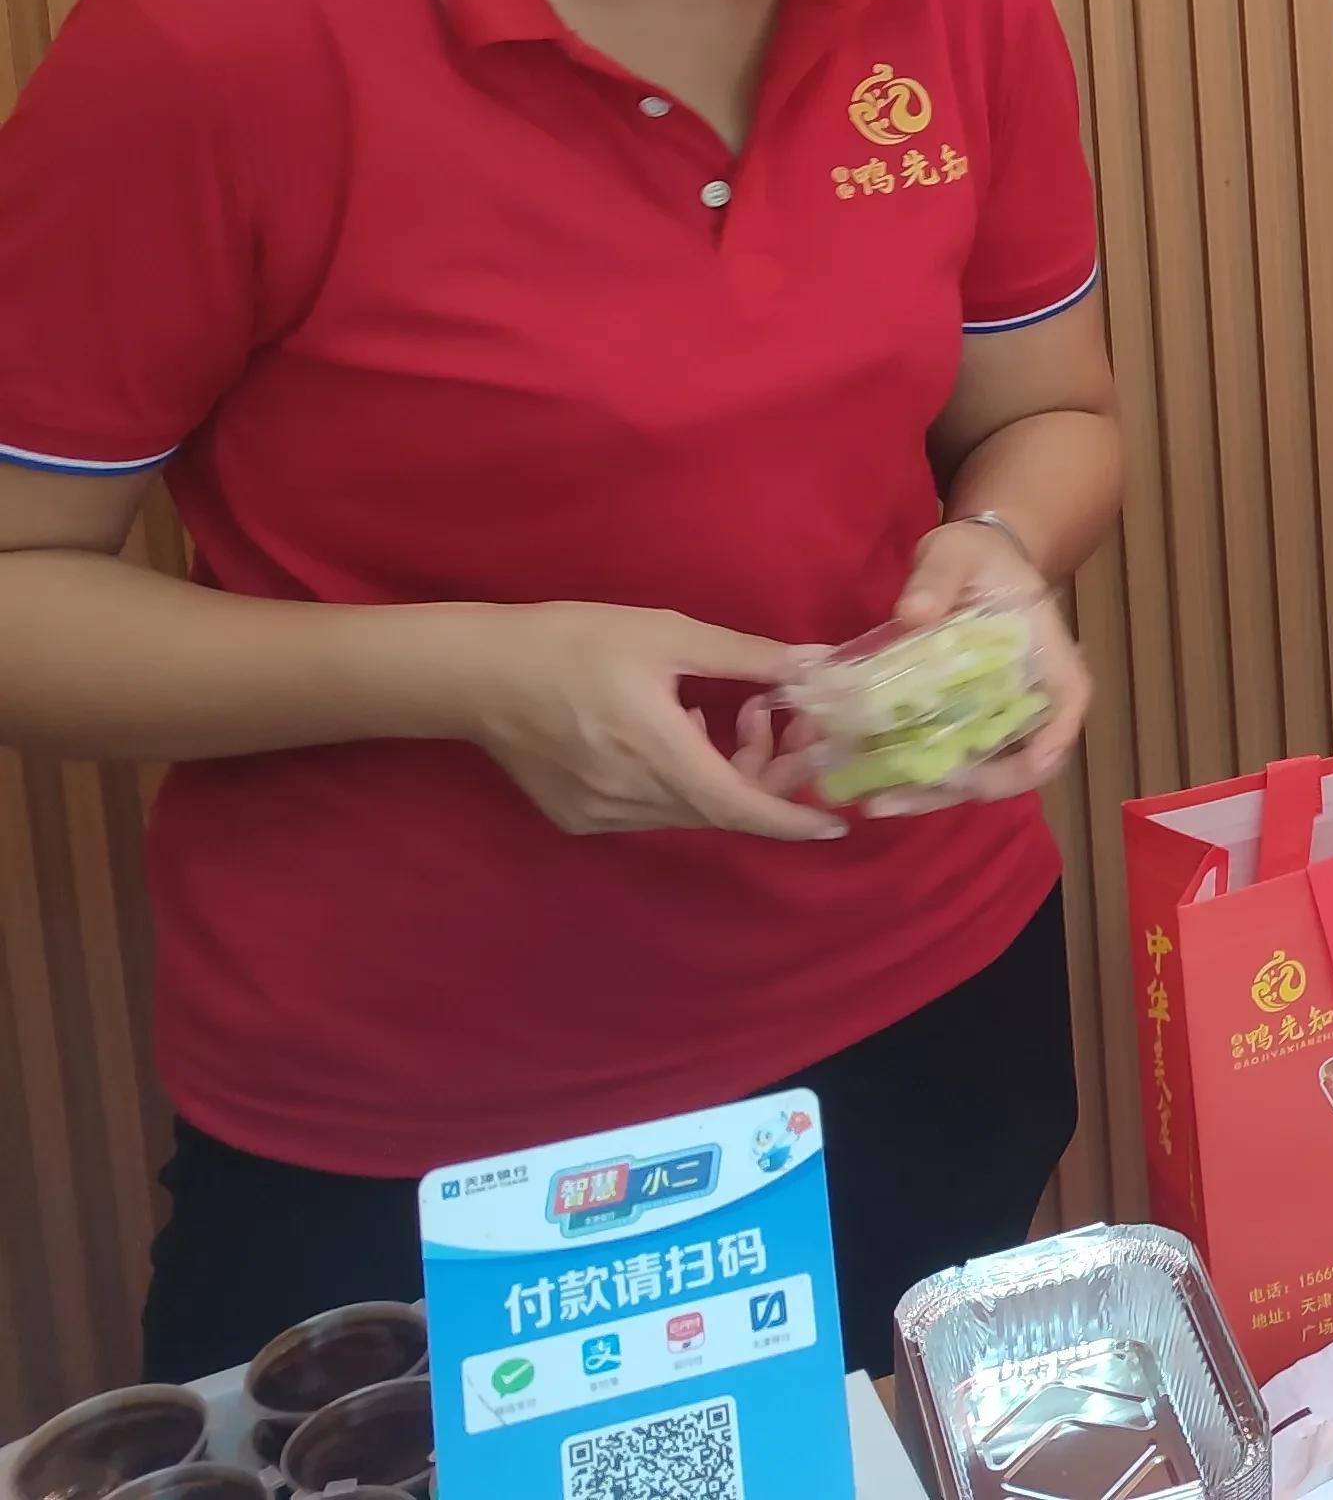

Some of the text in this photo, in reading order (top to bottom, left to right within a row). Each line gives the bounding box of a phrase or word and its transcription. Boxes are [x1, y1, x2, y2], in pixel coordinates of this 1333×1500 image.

[464, 1165, 528, 1188] 天津银行
[560, 1159, 701, 1209] 智慧 小二
[503, 1227, 768, 1335] 付款请扫码
